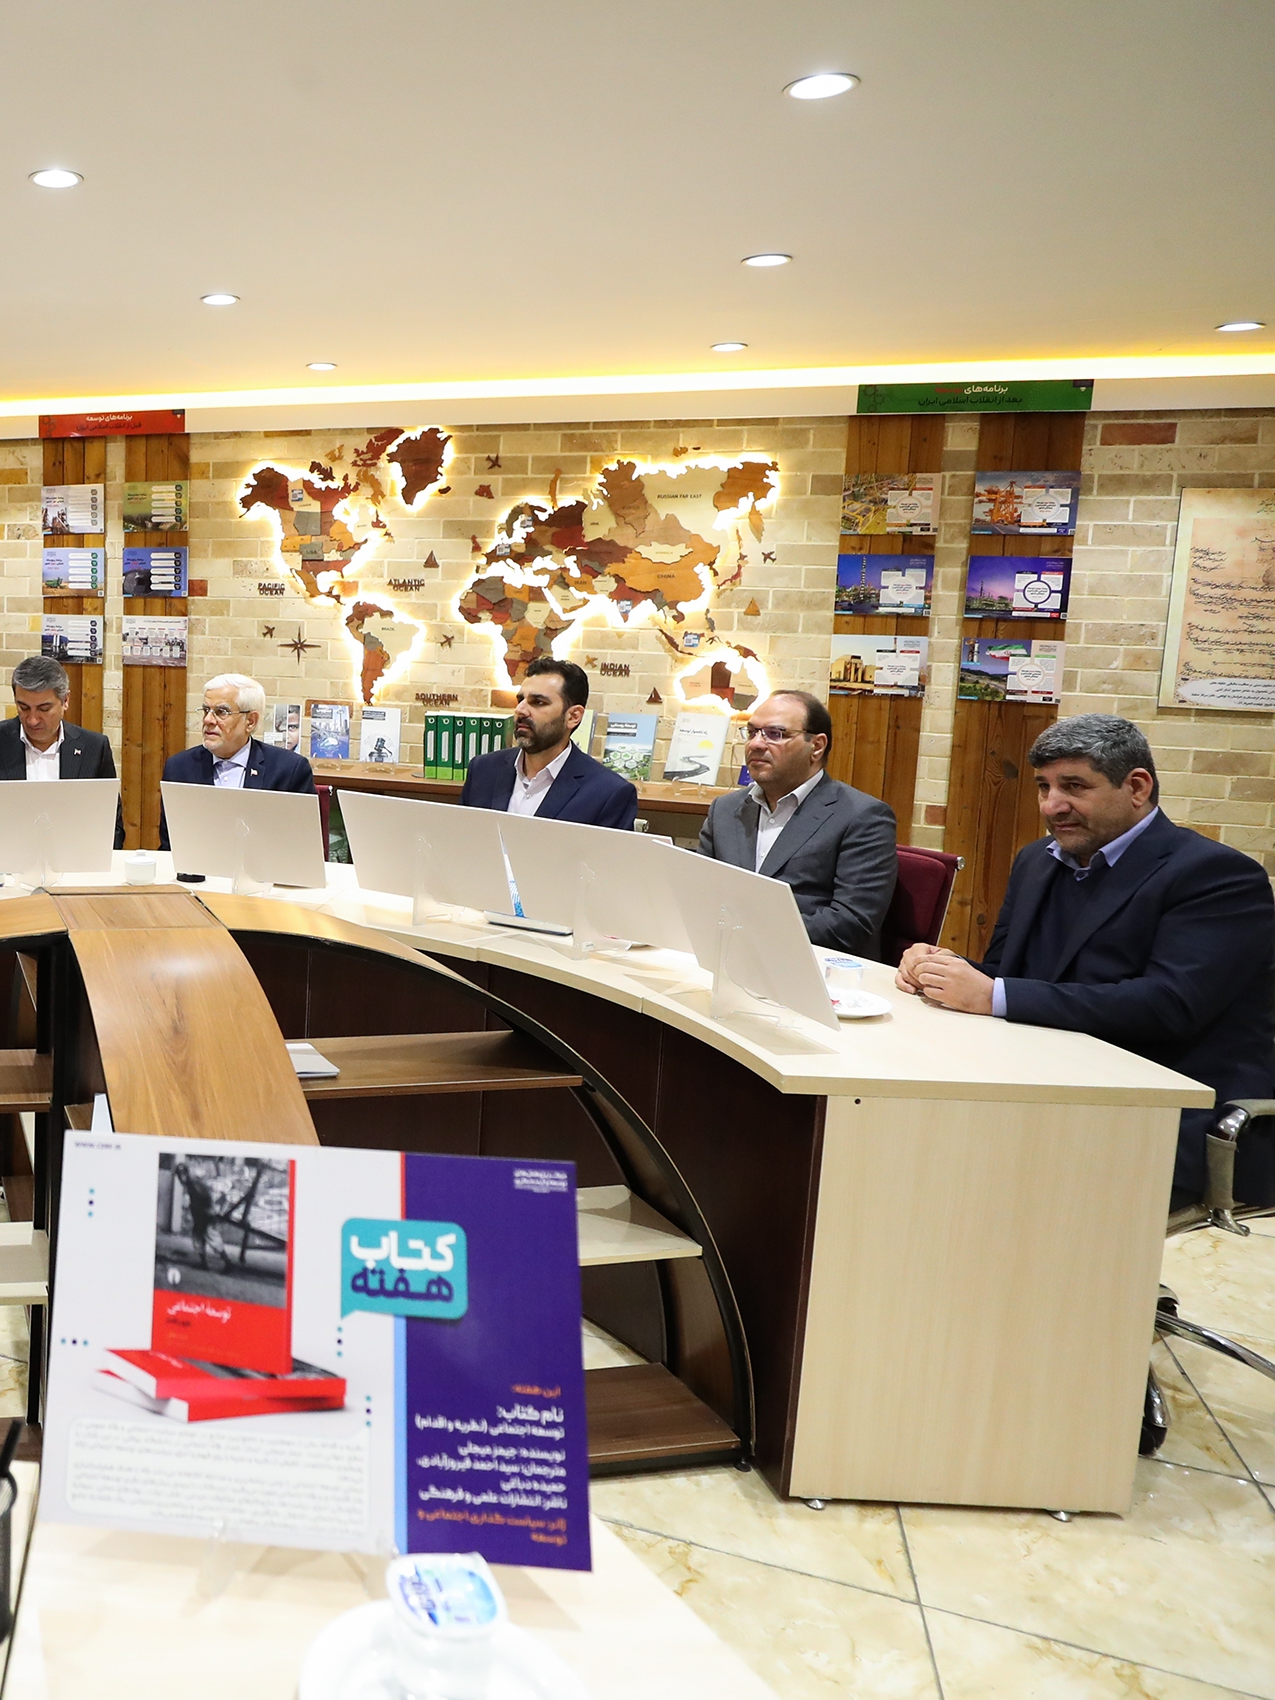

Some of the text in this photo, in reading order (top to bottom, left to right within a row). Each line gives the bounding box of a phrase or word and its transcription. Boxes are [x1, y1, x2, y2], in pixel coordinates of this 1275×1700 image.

[918, 397, 939, 406] ایران
[938, 396, 969, 406] اسلامی
[969, 396, 996, 404] انقلاب
[996, 396, 1004, 405] از
[86, 415, 105, 423] توسعه
[259, 588, 284, 596] OCEAN
[600, 669, 630, 677] OCEAN
[601, 662, 630, 671] INDIAN
[415, 693, 458, 701] SOUTHERN
[350, 1230, 457, 1272] کتاب
[350, 1267, 454, 1304] هفته
[167, 1299, 205, 1316] اجتماعی
[496, 1402, 565, 1426] نام کتاب:
[488, 1421, 531, 1438] اجتماعی
[531, 1425, 565, 1441] توسعه
[457, 1439, 493, 1457] میجلی
[492, 1444, 518, 1460] جیمز
[472, 1458, 499, 1471] احمد
[499, 1461, 521, 1475] سید
[418, 1483, 465, 1503] فرهنگی
[532, 1480, 567, 1495] حمیده
[472, 1489, 499, 1506] علمی
[499, 1491, 542, 1508] انتشارات
[425, 1508, 470, 1524] اجتماعی
[530, 1531, 568, 1547] توسعه
